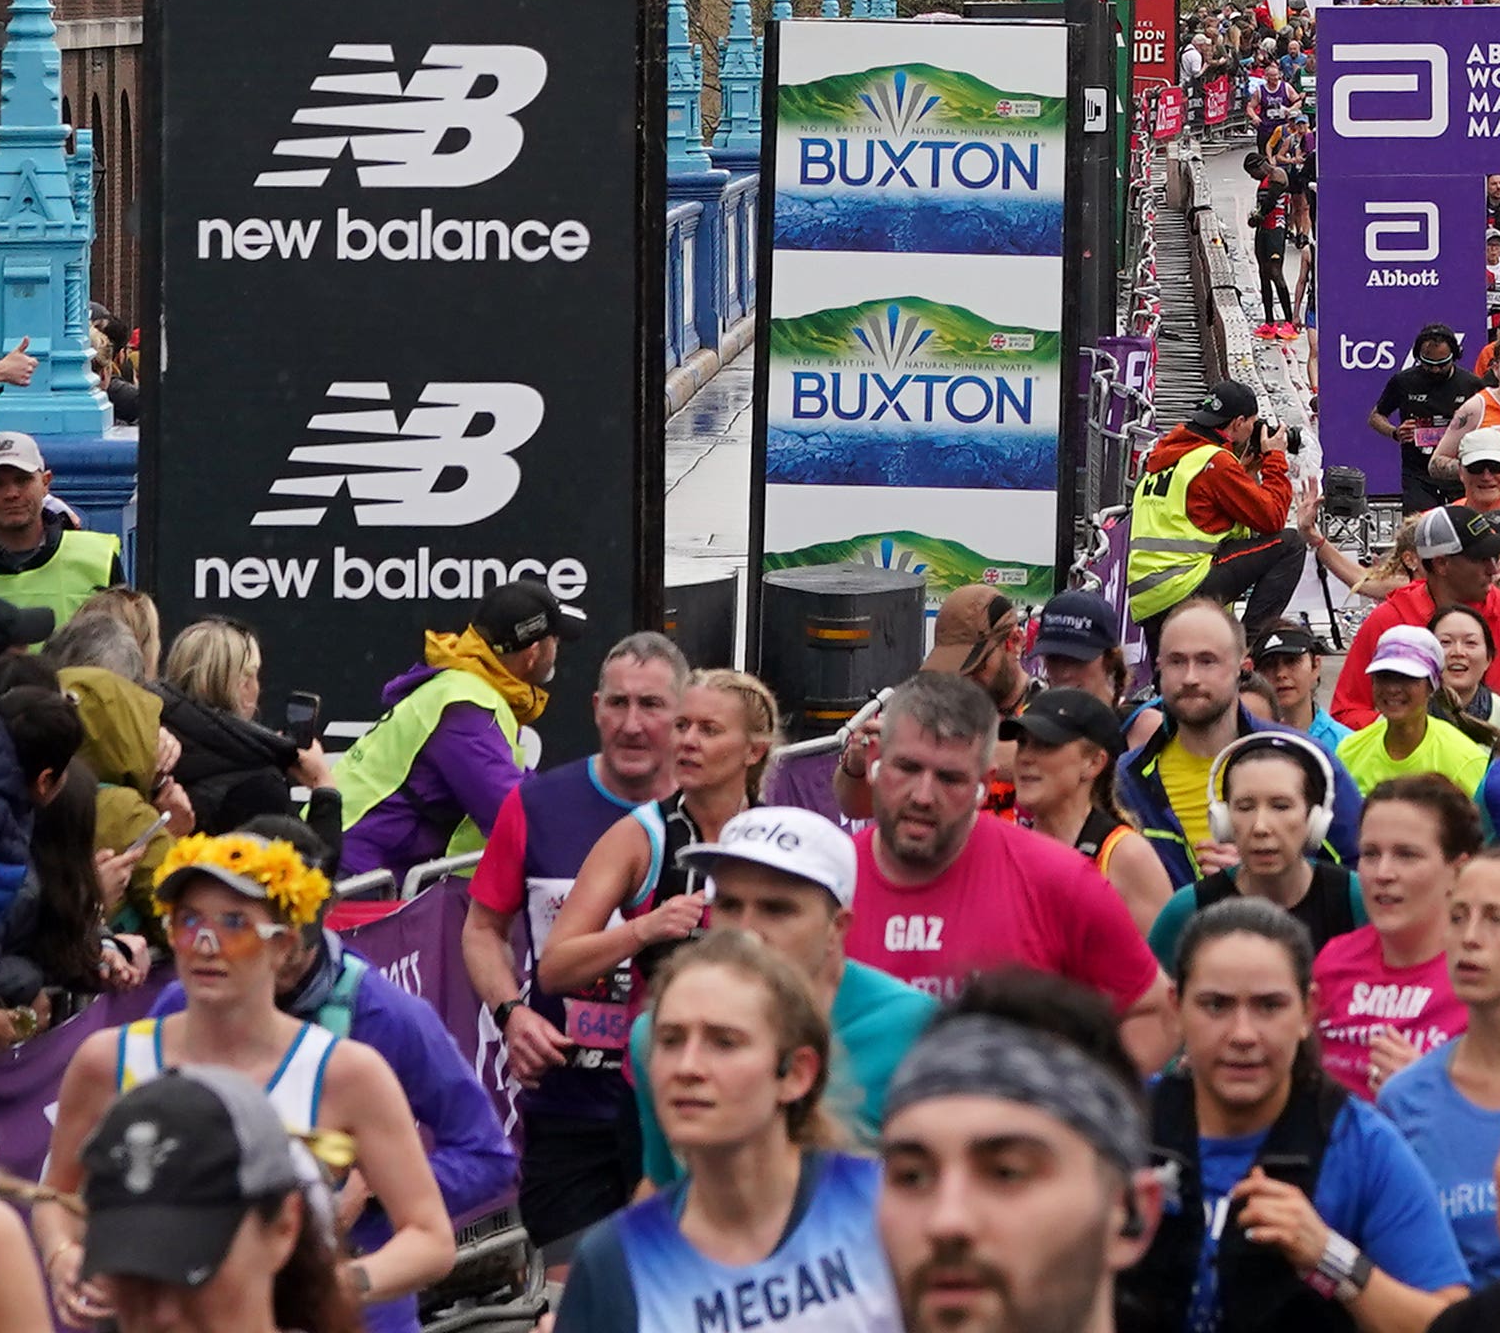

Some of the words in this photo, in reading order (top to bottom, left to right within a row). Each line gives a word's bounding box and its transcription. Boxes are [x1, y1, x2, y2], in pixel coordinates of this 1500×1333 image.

[1133, 43, 1165, 63] IDE
[1134, 30, 1165, 41] DON
[254, 44, 548, 188] NB
[798, 138, 1039, 191] BUXTON
[198, 218, 322, 260] new
[337, 208, 590, 261] balance
[1365, 268, 1440, 287] Abbott
[904, 361, 950, 369] NATURAL
[1000, 364, 1033, 372] WATER
[1338, 334, 1396, 370] tcs
[791, 371, 1032, 424] BUXTON
[250, 382, 545, 526] NB
[195, 557, 318, 599] new
[885, 914, 944, 952] GAZ
[1438, 1180, 1498, 1220] HRIS
[693, 1246, 857, 1333] MEGAN
